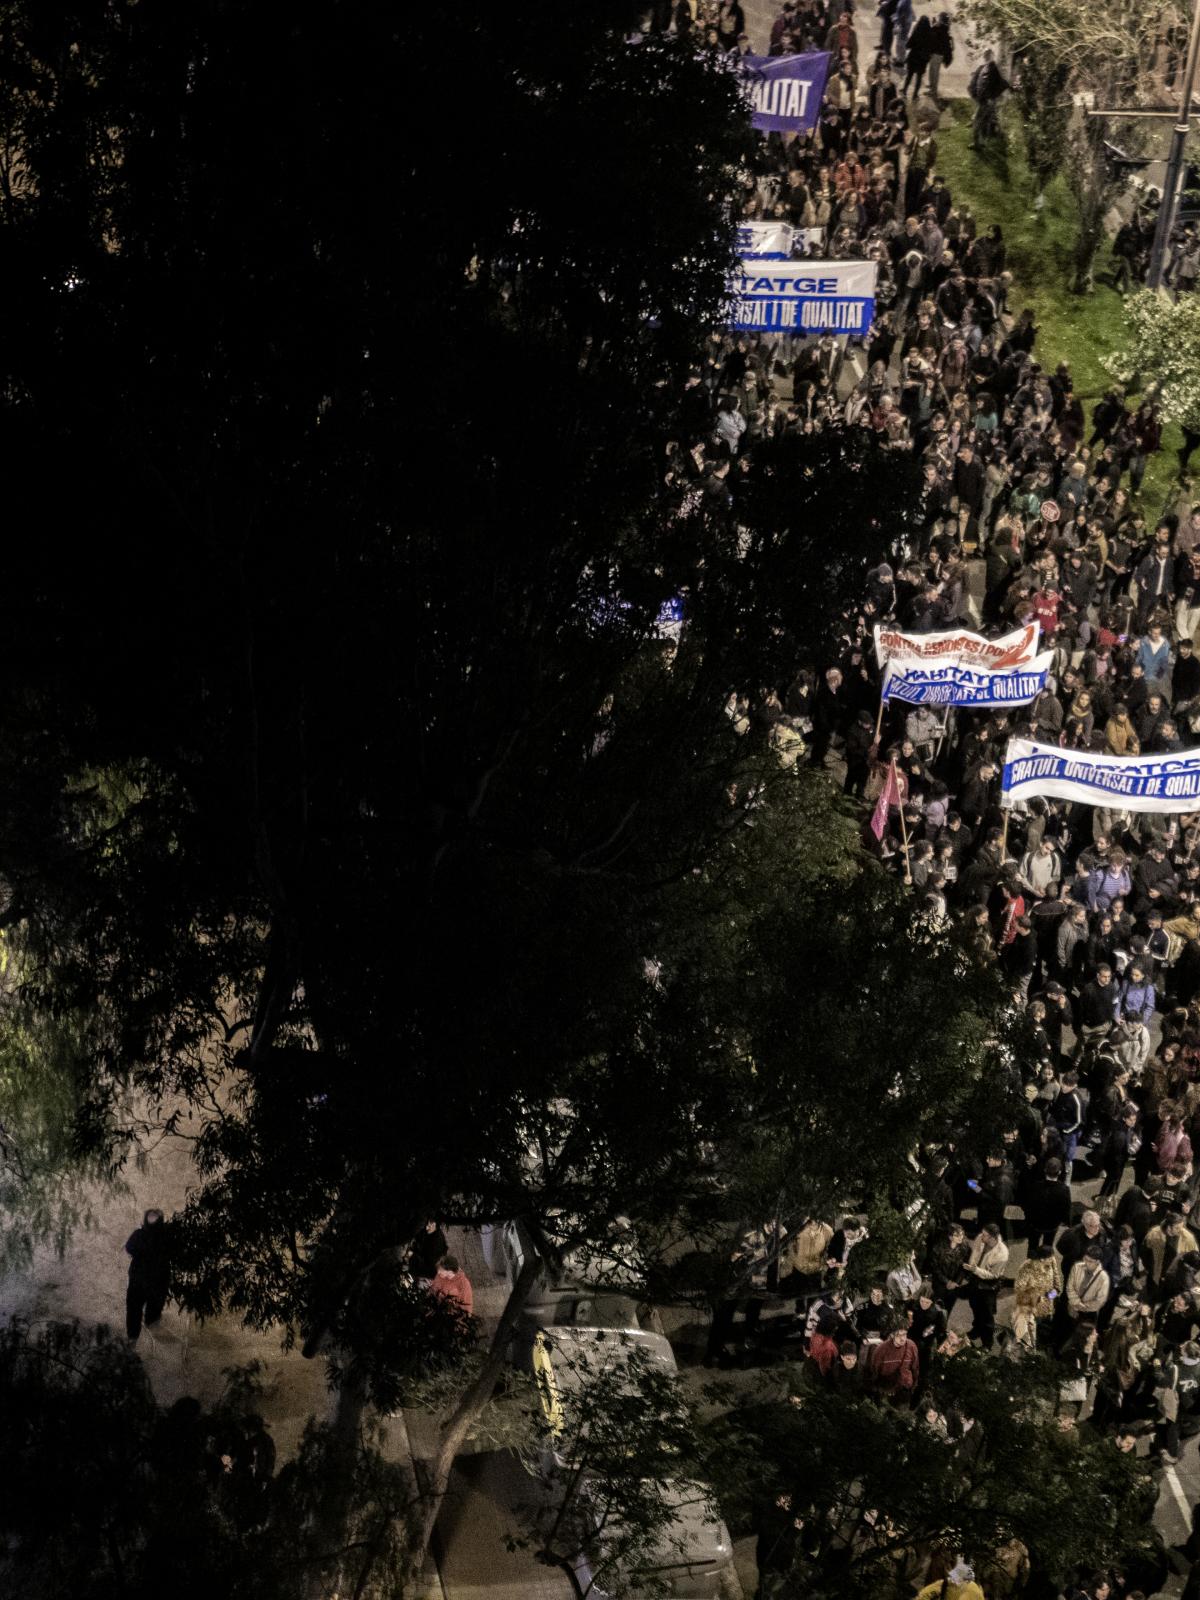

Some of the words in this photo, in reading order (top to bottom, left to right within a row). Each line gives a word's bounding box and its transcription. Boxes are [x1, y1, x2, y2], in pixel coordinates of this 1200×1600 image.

[751, 79, 813, 117] ALITAT
[739, 277, 838, 293] TATGE
[771, 301, 779, 326] I
[780, 301, 799, 328] DE
[801, 302, 865, 329] QUALITAT
[903, 667, 992, 687] HABITAT
[993, 677, 1041, 700] QUALITAT
[1064, 761, 1134, 794] UNIVERSAL
[1136, 778, 1144, 794] I
[1145, 777, 1163, 795] DE
